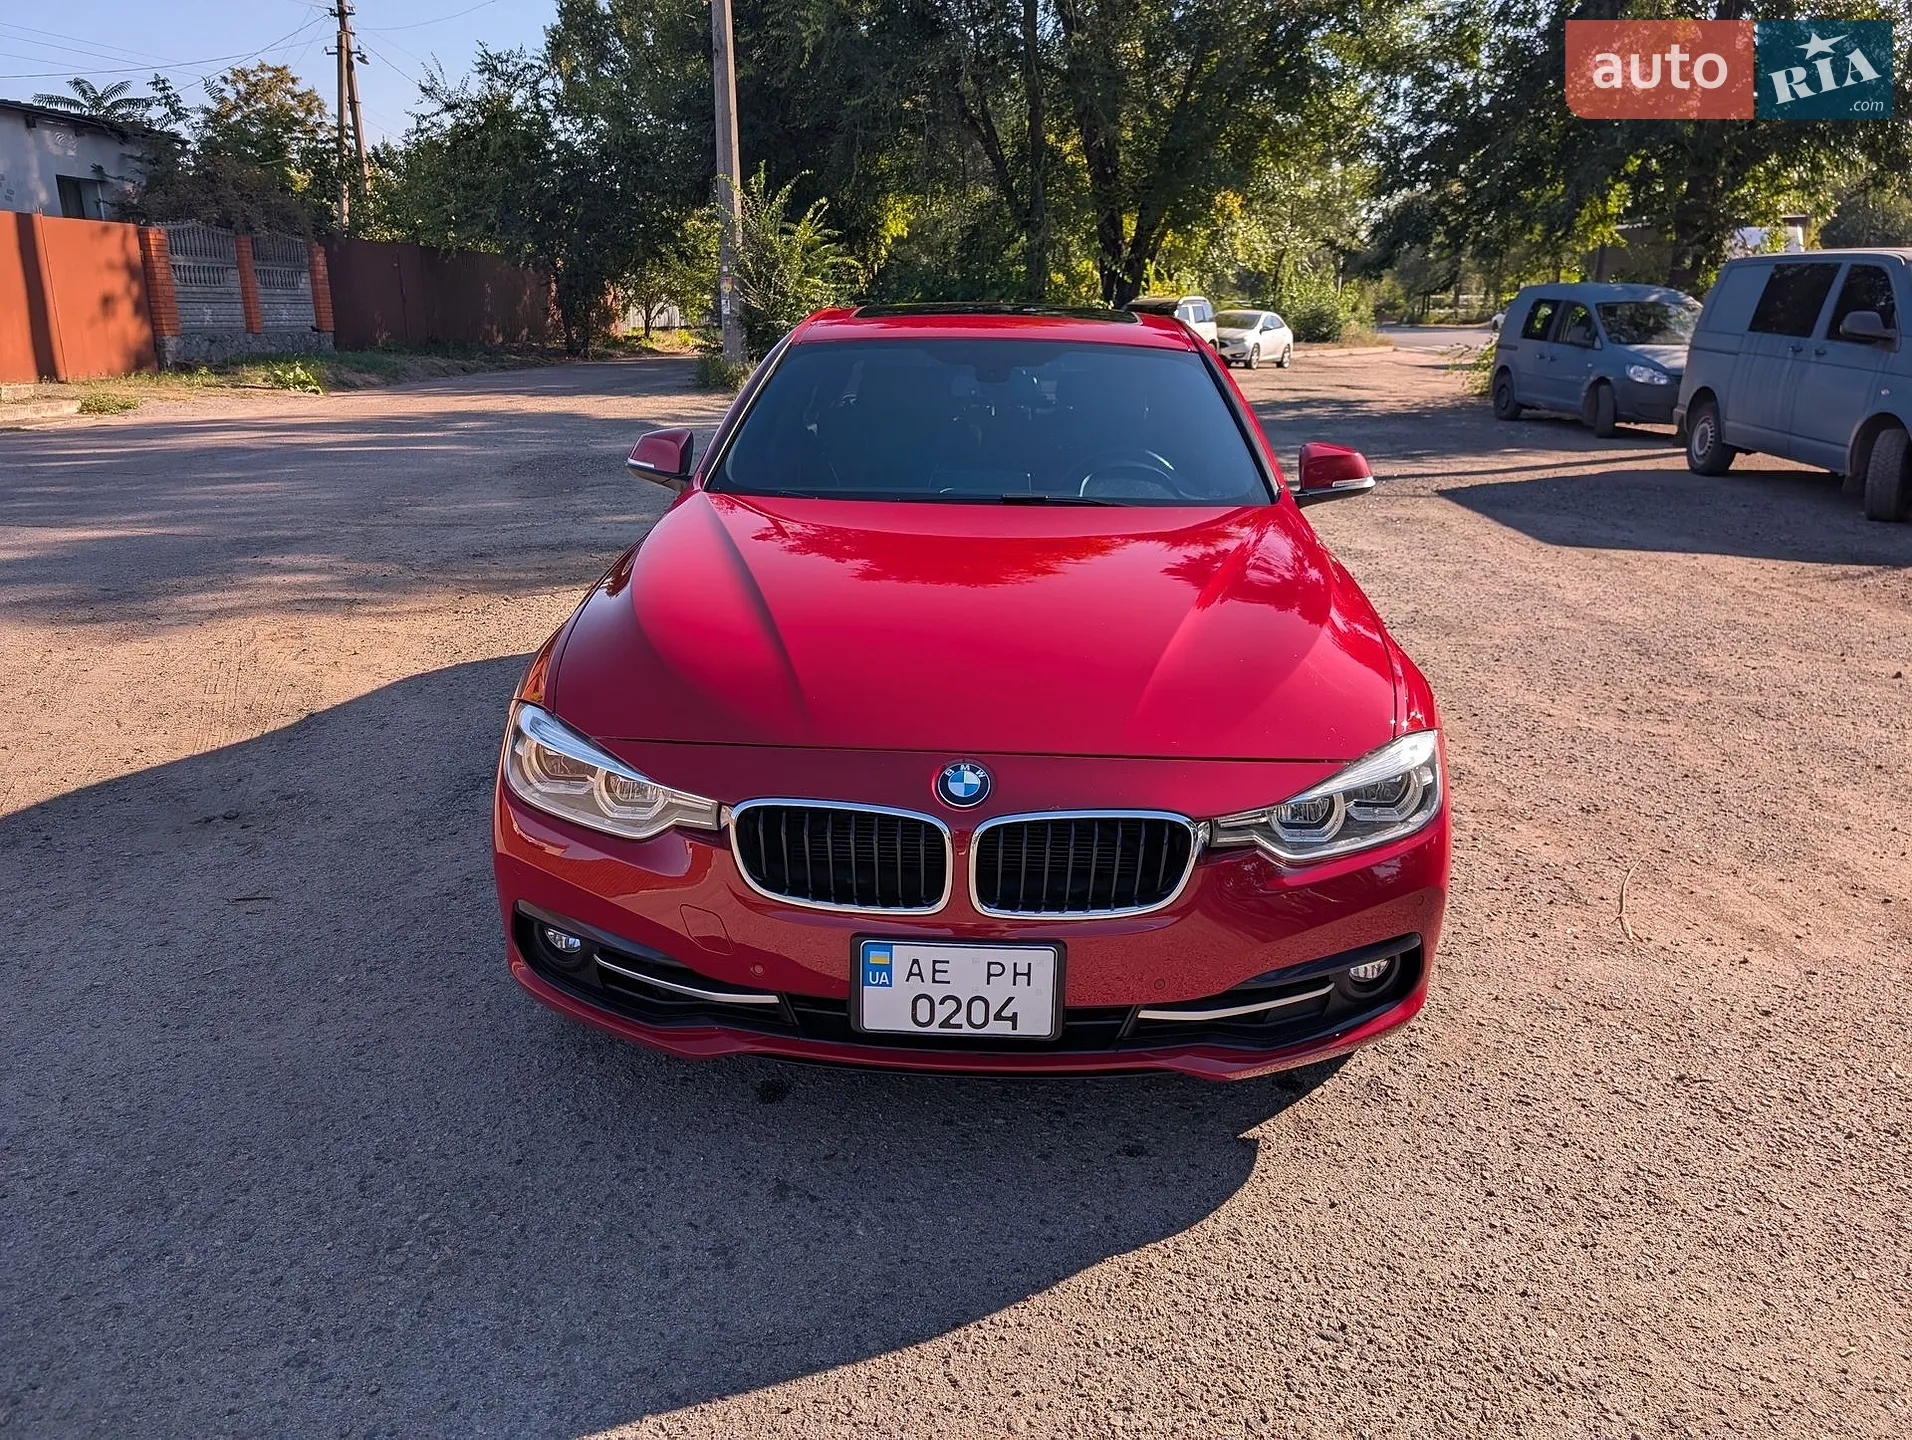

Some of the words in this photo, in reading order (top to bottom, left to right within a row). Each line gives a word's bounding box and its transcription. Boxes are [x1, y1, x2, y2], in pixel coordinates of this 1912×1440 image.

[944, 764, 986, 778] BMW
[869, 972, 890, 985] UA
[905, 958, 951, 984] AE
[986, 961, 1032, 987] PH
[911, 993, 1018, 1031] 0204
